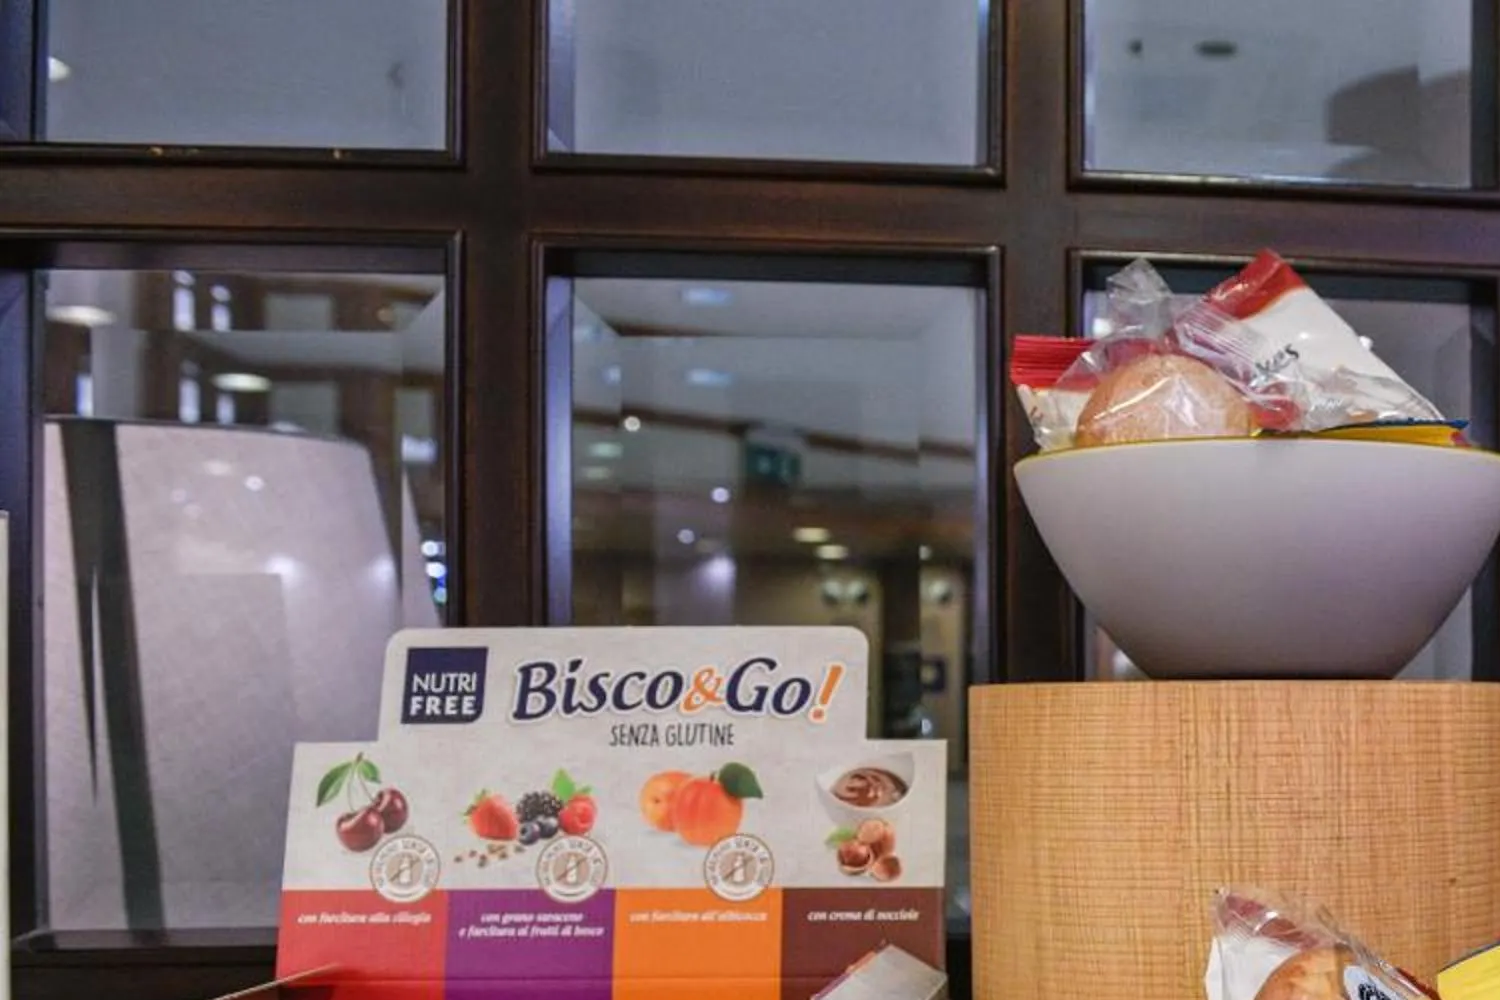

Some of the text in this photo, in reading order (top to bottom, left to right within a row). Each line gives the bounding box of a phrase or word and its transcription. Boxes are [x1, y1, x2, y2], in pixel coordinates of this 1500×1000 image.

[412, 672, 477, 692] NUTRI
[511, 657, 843, 721] Bisco&Go!
[410, 694, 476, 716] FREE
[609, 722, 735, 747] SENZA GLUTINE
[807, 911, 827, 921] con
